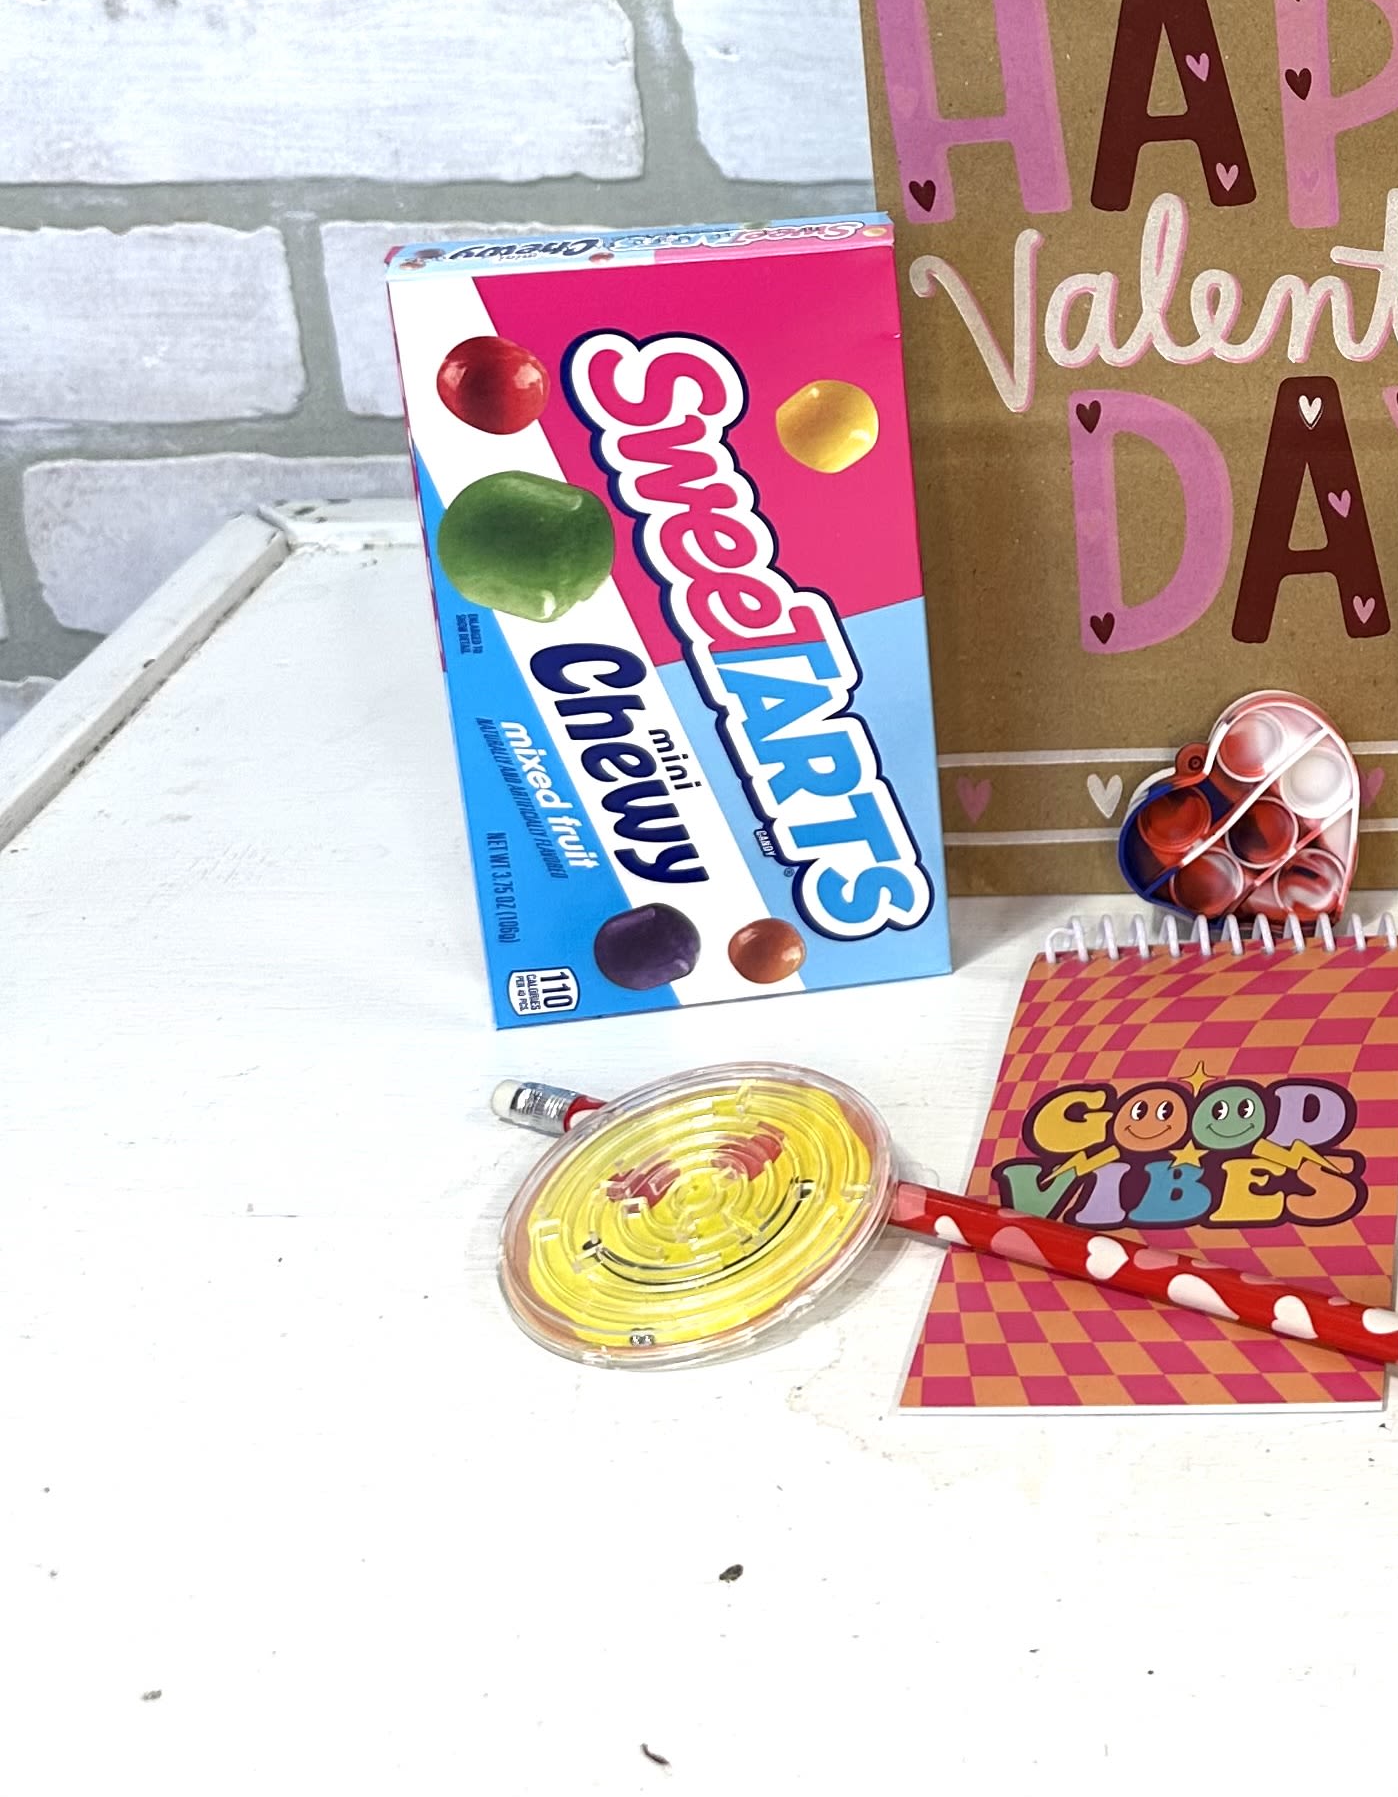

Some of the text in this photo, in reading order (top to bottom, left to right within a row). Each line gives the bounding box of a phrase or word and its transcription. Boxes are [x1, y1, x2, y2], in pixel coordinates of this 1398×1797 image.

[449, 239, 600, 261] Chewy
[529, 643, 709, 883] Chewy
[648, 728, 702, 790] mini
[501, 722, 600, 868] mixed fruit
[486, 832, 508, 851] NET
[534, 836, 568, 879] FLAVORED
[756, 830, 776, 856] CANDY
[489, 853, 511, 869] WT
[492, 871, 514, 894] 3.75
[495, 895, 516, 911] OZ
[526, 974, 541, 1010] CALORIES
[540, 972, 573, 1009] 110
[1030, 1082, 1349, 1154] GOOD
[1000, 1153, 1359, 1226] VIBES
